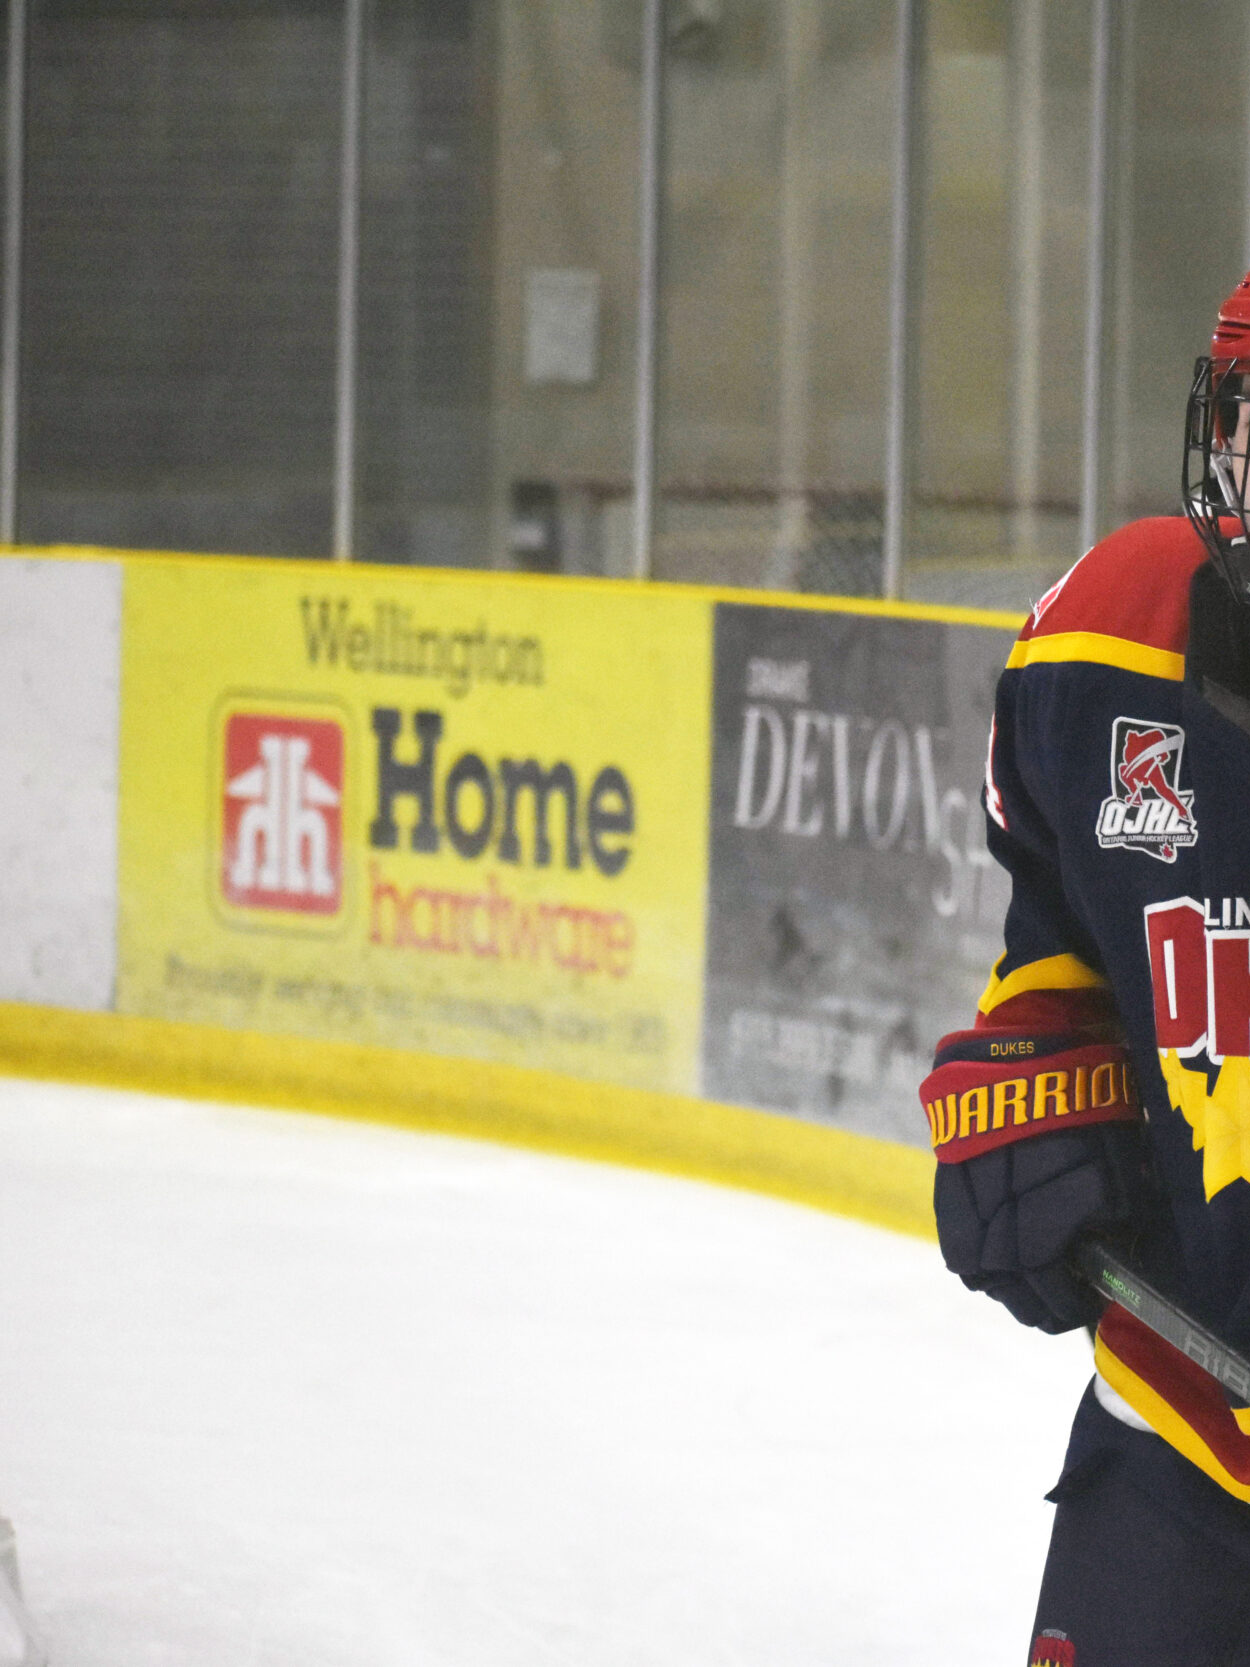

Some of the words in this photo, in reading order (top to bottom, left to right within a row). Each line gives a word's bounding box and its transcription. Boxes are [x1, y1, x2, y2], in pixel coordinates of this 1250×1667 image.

[300, 596, 546, 698] Wellington
[367, 704, 637, 879] Home
[1100, 798, 1192, 836] OJHL
[367, 859, 635, 979] hardware
[990, 1041, 1036, 1057] DUKES
[926, 1062, 1130, 1150] WARRIO
